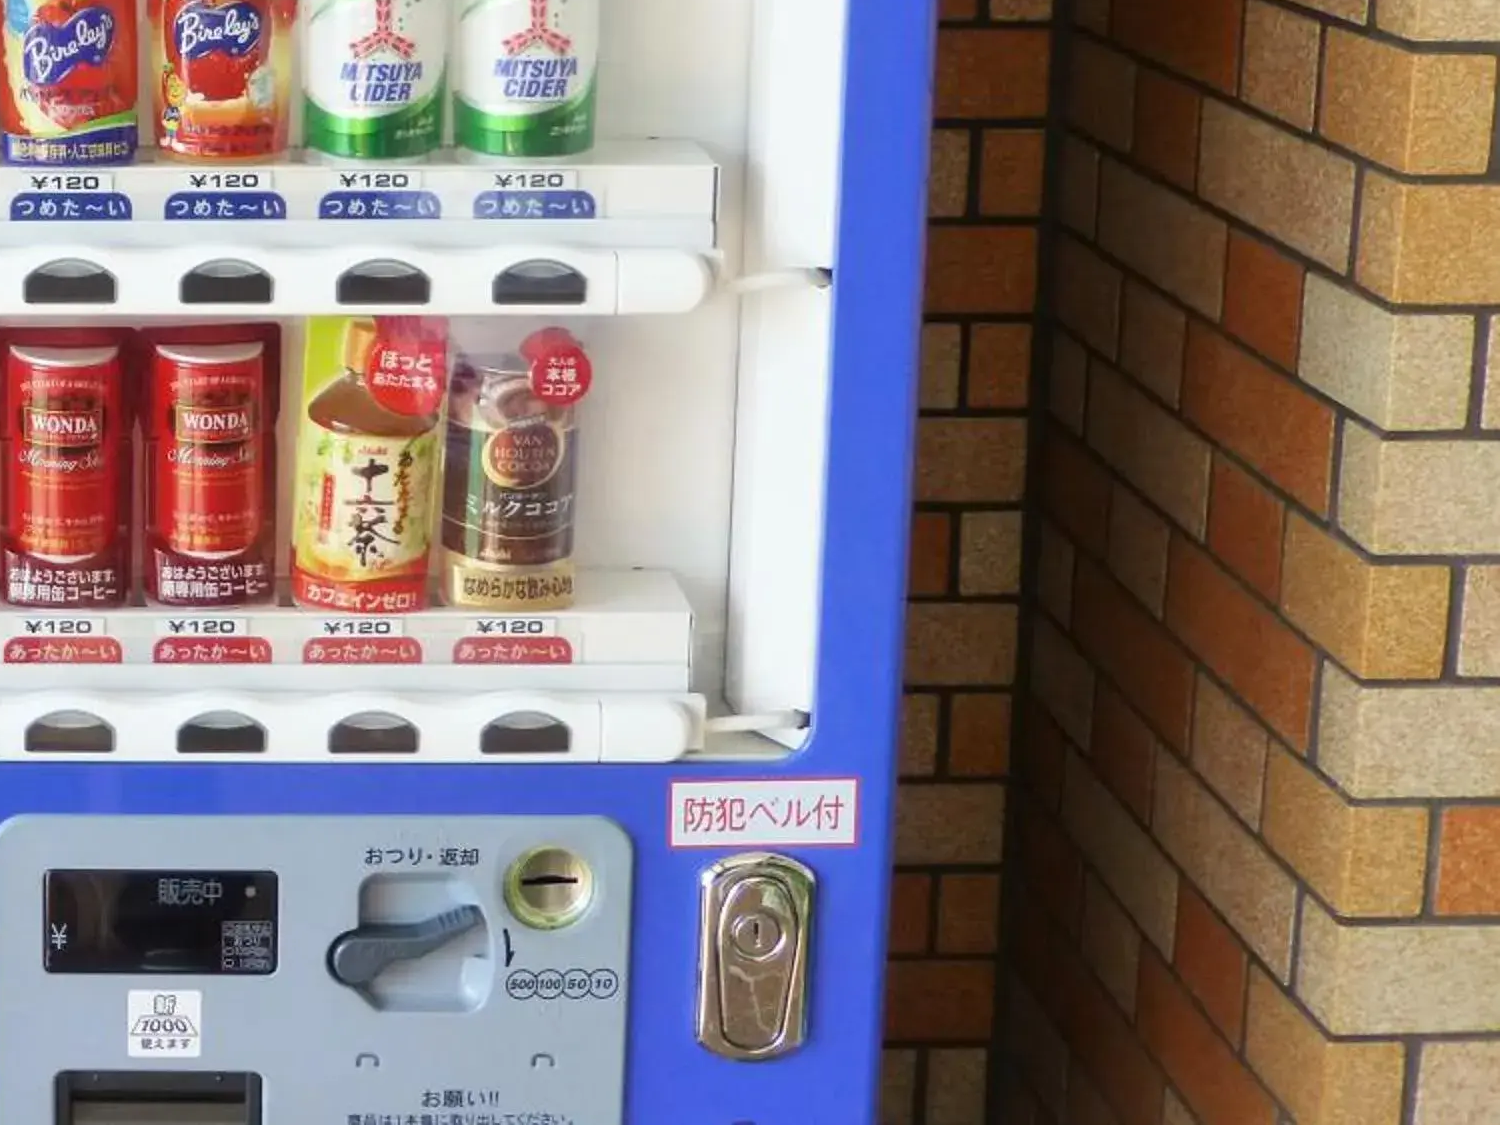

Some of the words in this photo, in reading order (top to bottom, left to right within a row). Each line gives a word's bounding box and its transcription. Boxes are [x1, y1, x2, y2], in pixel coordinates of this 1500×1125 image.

[177, 7, 259, 53] Bireley's
[26, 15, 113, 83] Bireley's
[340, 61, 423, 82] MTSUYA
[494, 56, 578, 78] MITSUYA
[503, 78, 568, 98] CIDER
[31, 176, 100, 190] ¥120
[189, 174, 259, 188] ¥120
[340, 174, 409, 188] ¥120
[495, 174, 564, 188] ¥120
[380, 349, 433, 372] ほっと
[541, 381, 581, 396] ココア
[30, 413, 98, 434] WONDA
[183, 411, 248, 431] WONDA
[343, 458, 402, 567] 十六茶
[465, 491, 574, 518] ミルクココア
[25, 620, 92, 634] ¥120
[169, 620, 236, 634] ¥120
[323, 621, 391, 634] ¥120
[476, 620, 543, 634] ¥120
[683, 794, 845, 834] 防犯ベル付
[364, 847, 480, 867] おつり・返却
[157, 878, 223, 906] 販売中
[510, 978, 536, 990] 500
[538, 978, 561, 990] 100
[566, 978, 587, 990] 50
[594, 978, 613, 990] 10
[141, 1018, 188, 1033] 1000
[140, 1037, 192, 1050] 使えます
